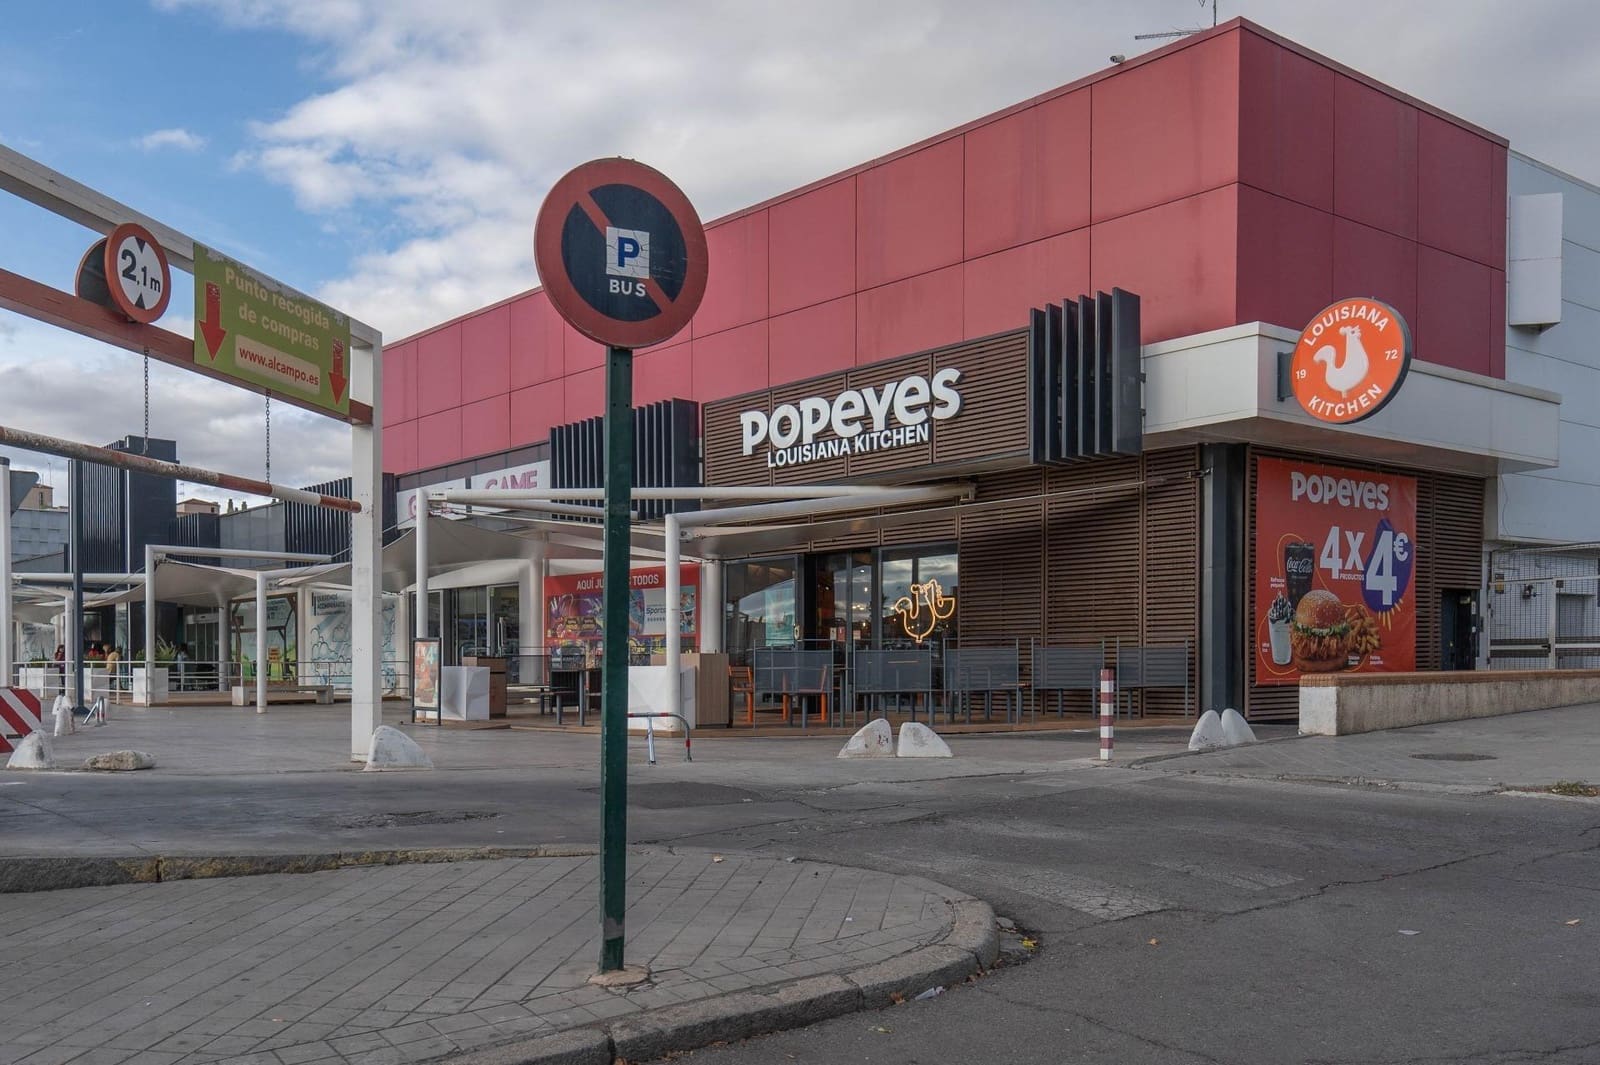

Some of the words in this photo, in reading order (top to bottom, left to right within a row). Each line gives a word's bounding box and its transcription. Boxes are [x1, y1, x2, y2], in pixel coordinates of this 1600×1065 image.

[617, 236, 640, 268] P
[225, 267, 268, 301] Punto
[272, 291, 330, 330] recogida
[609, 279, 646, 297] BUS
[238, 303, 257, 324] de
[261, 317, 319, 350] compras
[1304, 305, 1389, 346] LOUISIANA
[239, 346, 319, 386] www.alcampo.es
[1385, 349, 1398, 360] 72
[1295, 369, 1307, 380] 19
[1308, 383, 1382, 417] KITCHEN
[767, 440, 850, 468] LOUISIANA
[854, 423, 930, 453] KITCHEN
[576, 577, 594, 591] AQUÍ
[632, 574, 659, 586] TODOS
